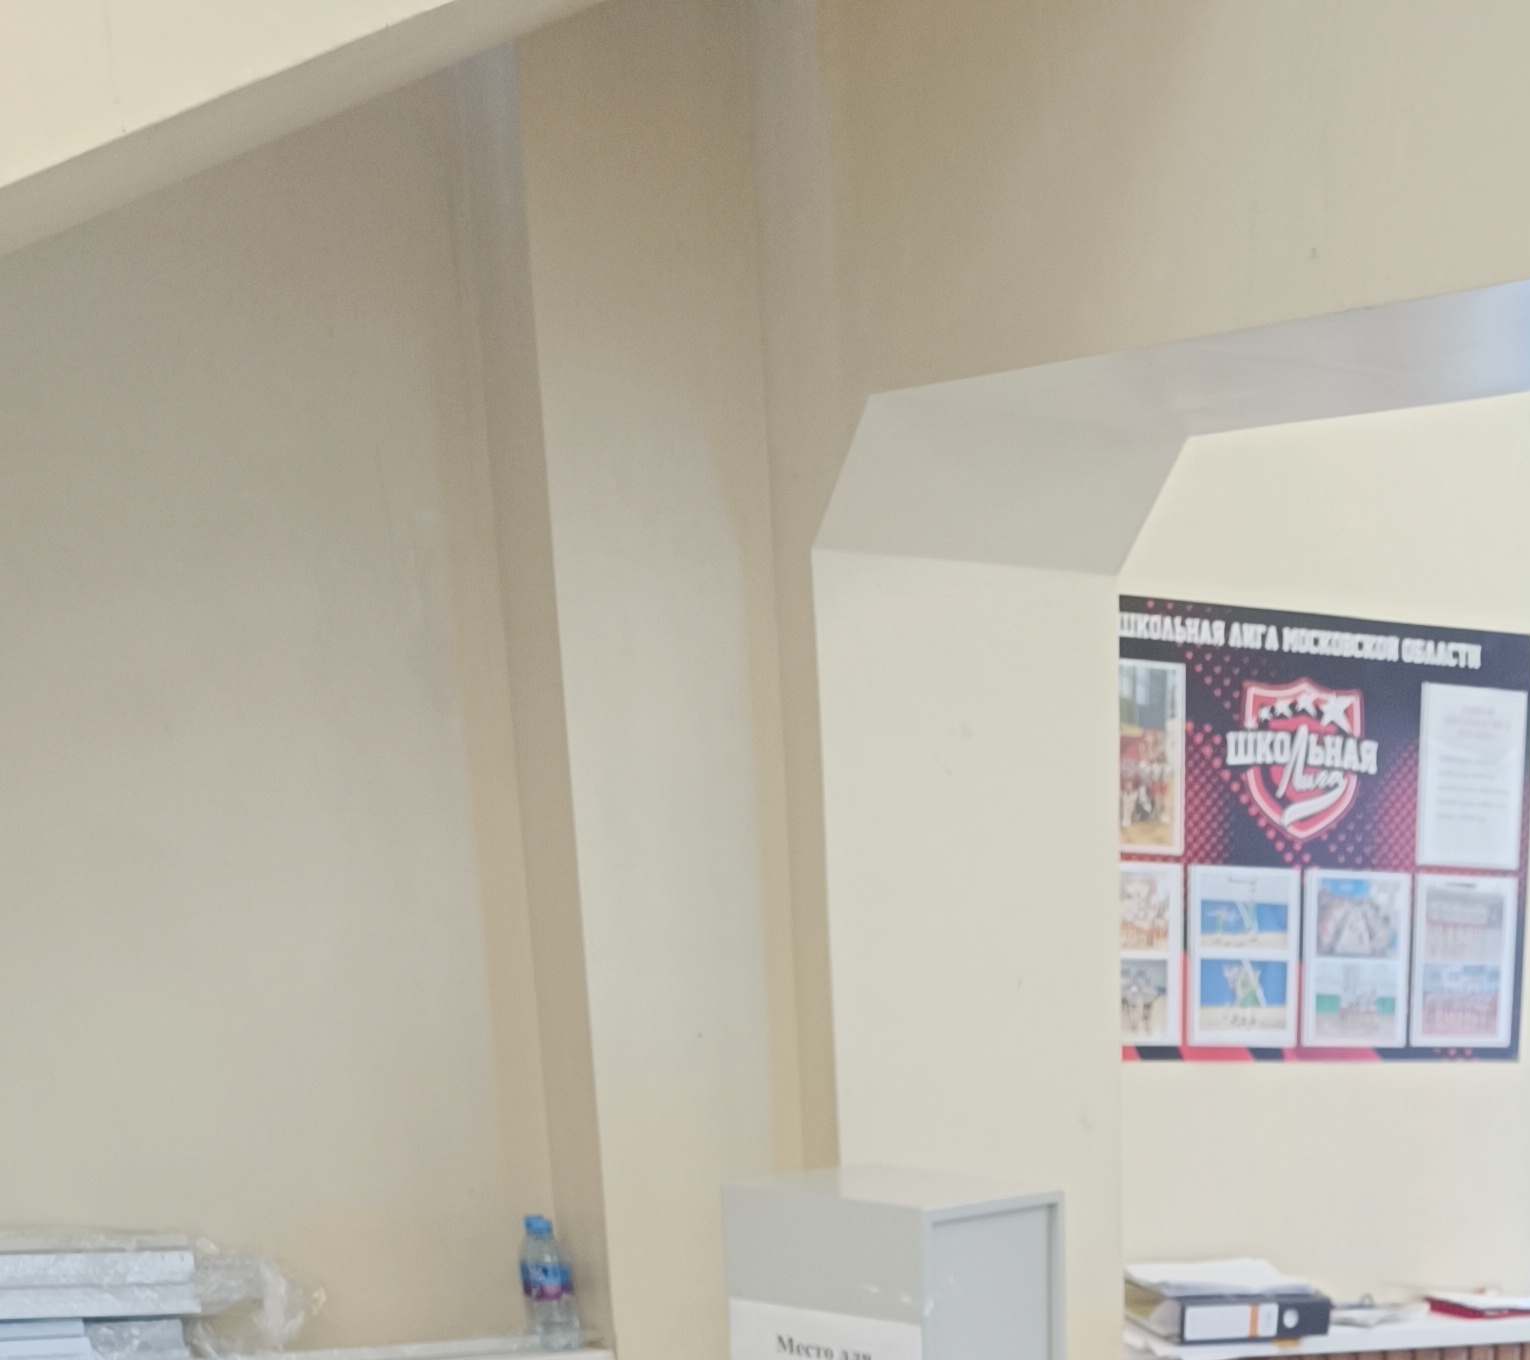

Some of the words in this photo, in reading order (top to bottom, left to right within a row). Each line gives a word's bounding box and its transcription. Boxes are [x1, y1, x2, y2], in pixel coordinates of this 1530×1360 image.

[1120, 612, 1225, 646] ШКОЛЬНАЯ
[1229, 621, 1279, 652] ЛИГА
[1282, 626, 1399, 662] МОСКОВСКОЙ
[1402, 637, 1482, 669] ОБЛАСТИ
[1226, 724, 1378, 775] ШКОЛЬНАЯ
[776, 1333, 834, 1360] Место
